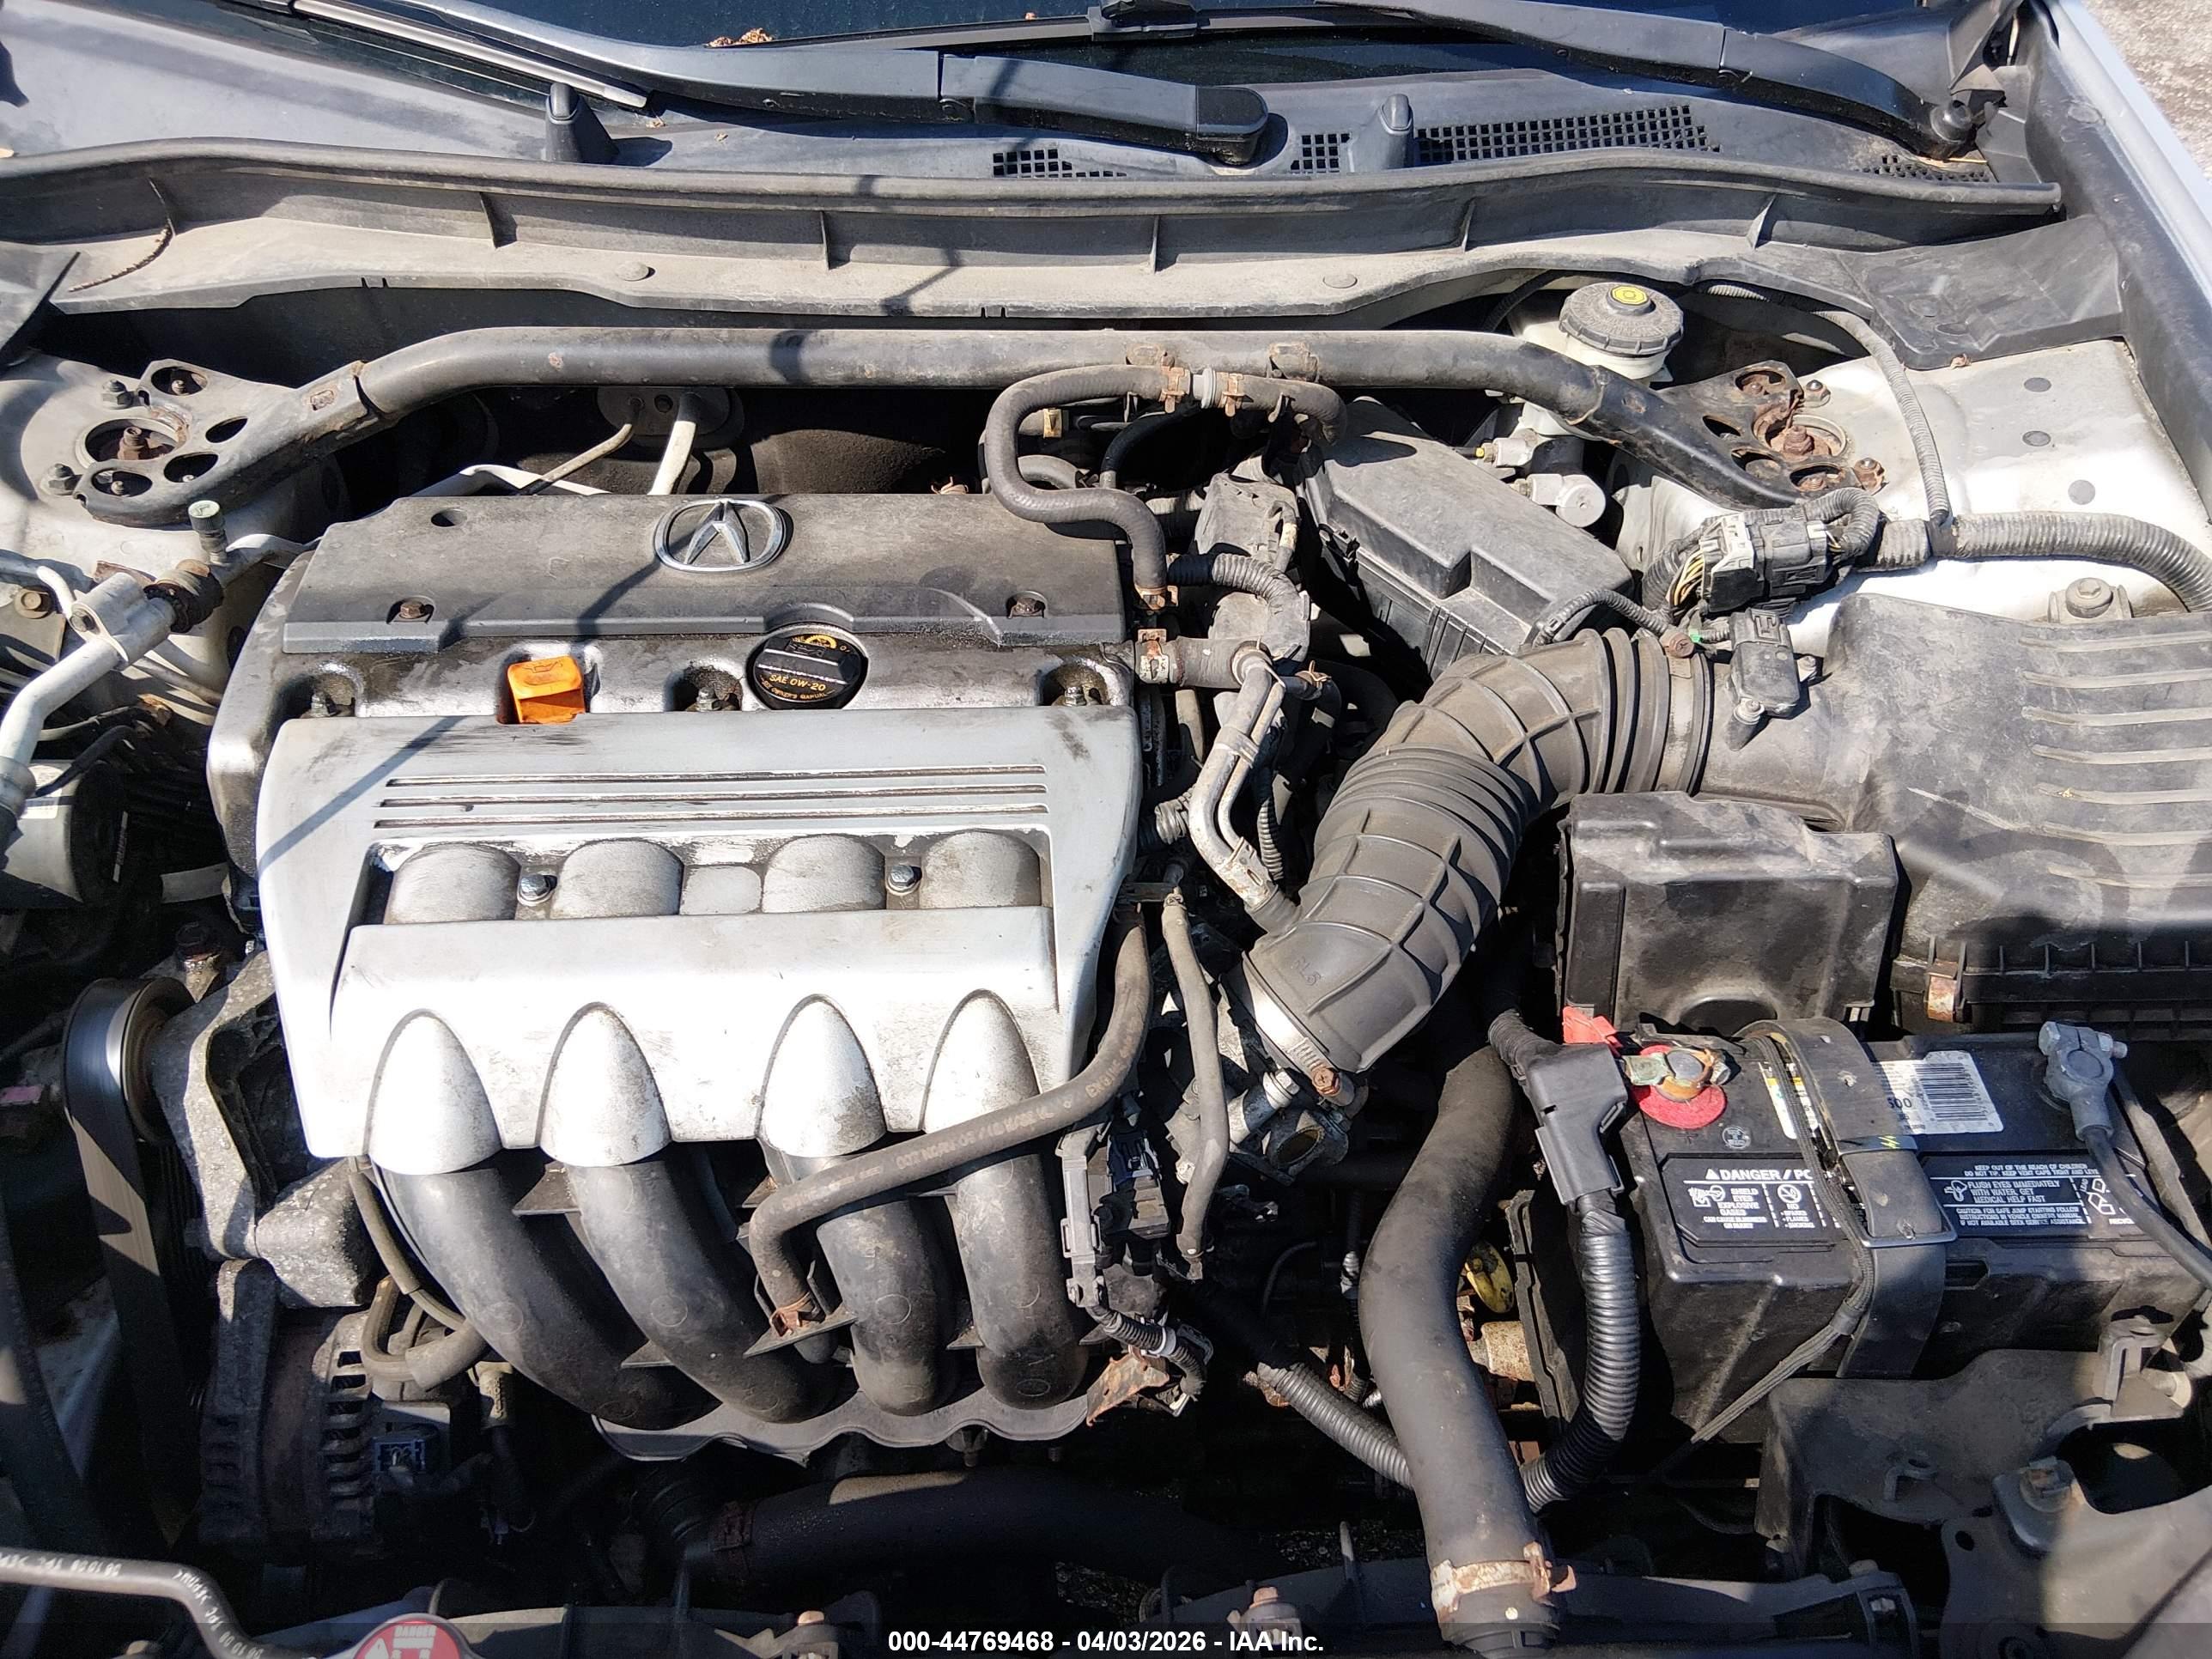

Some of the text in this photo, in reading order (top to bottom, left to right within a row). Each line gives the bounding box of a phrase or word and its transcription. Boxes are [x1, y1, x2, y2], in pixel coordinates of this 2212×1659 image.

[769, 675, 826, 691] SAE 0W-20
[1720, 1170, 1782, 1180] DANGER
